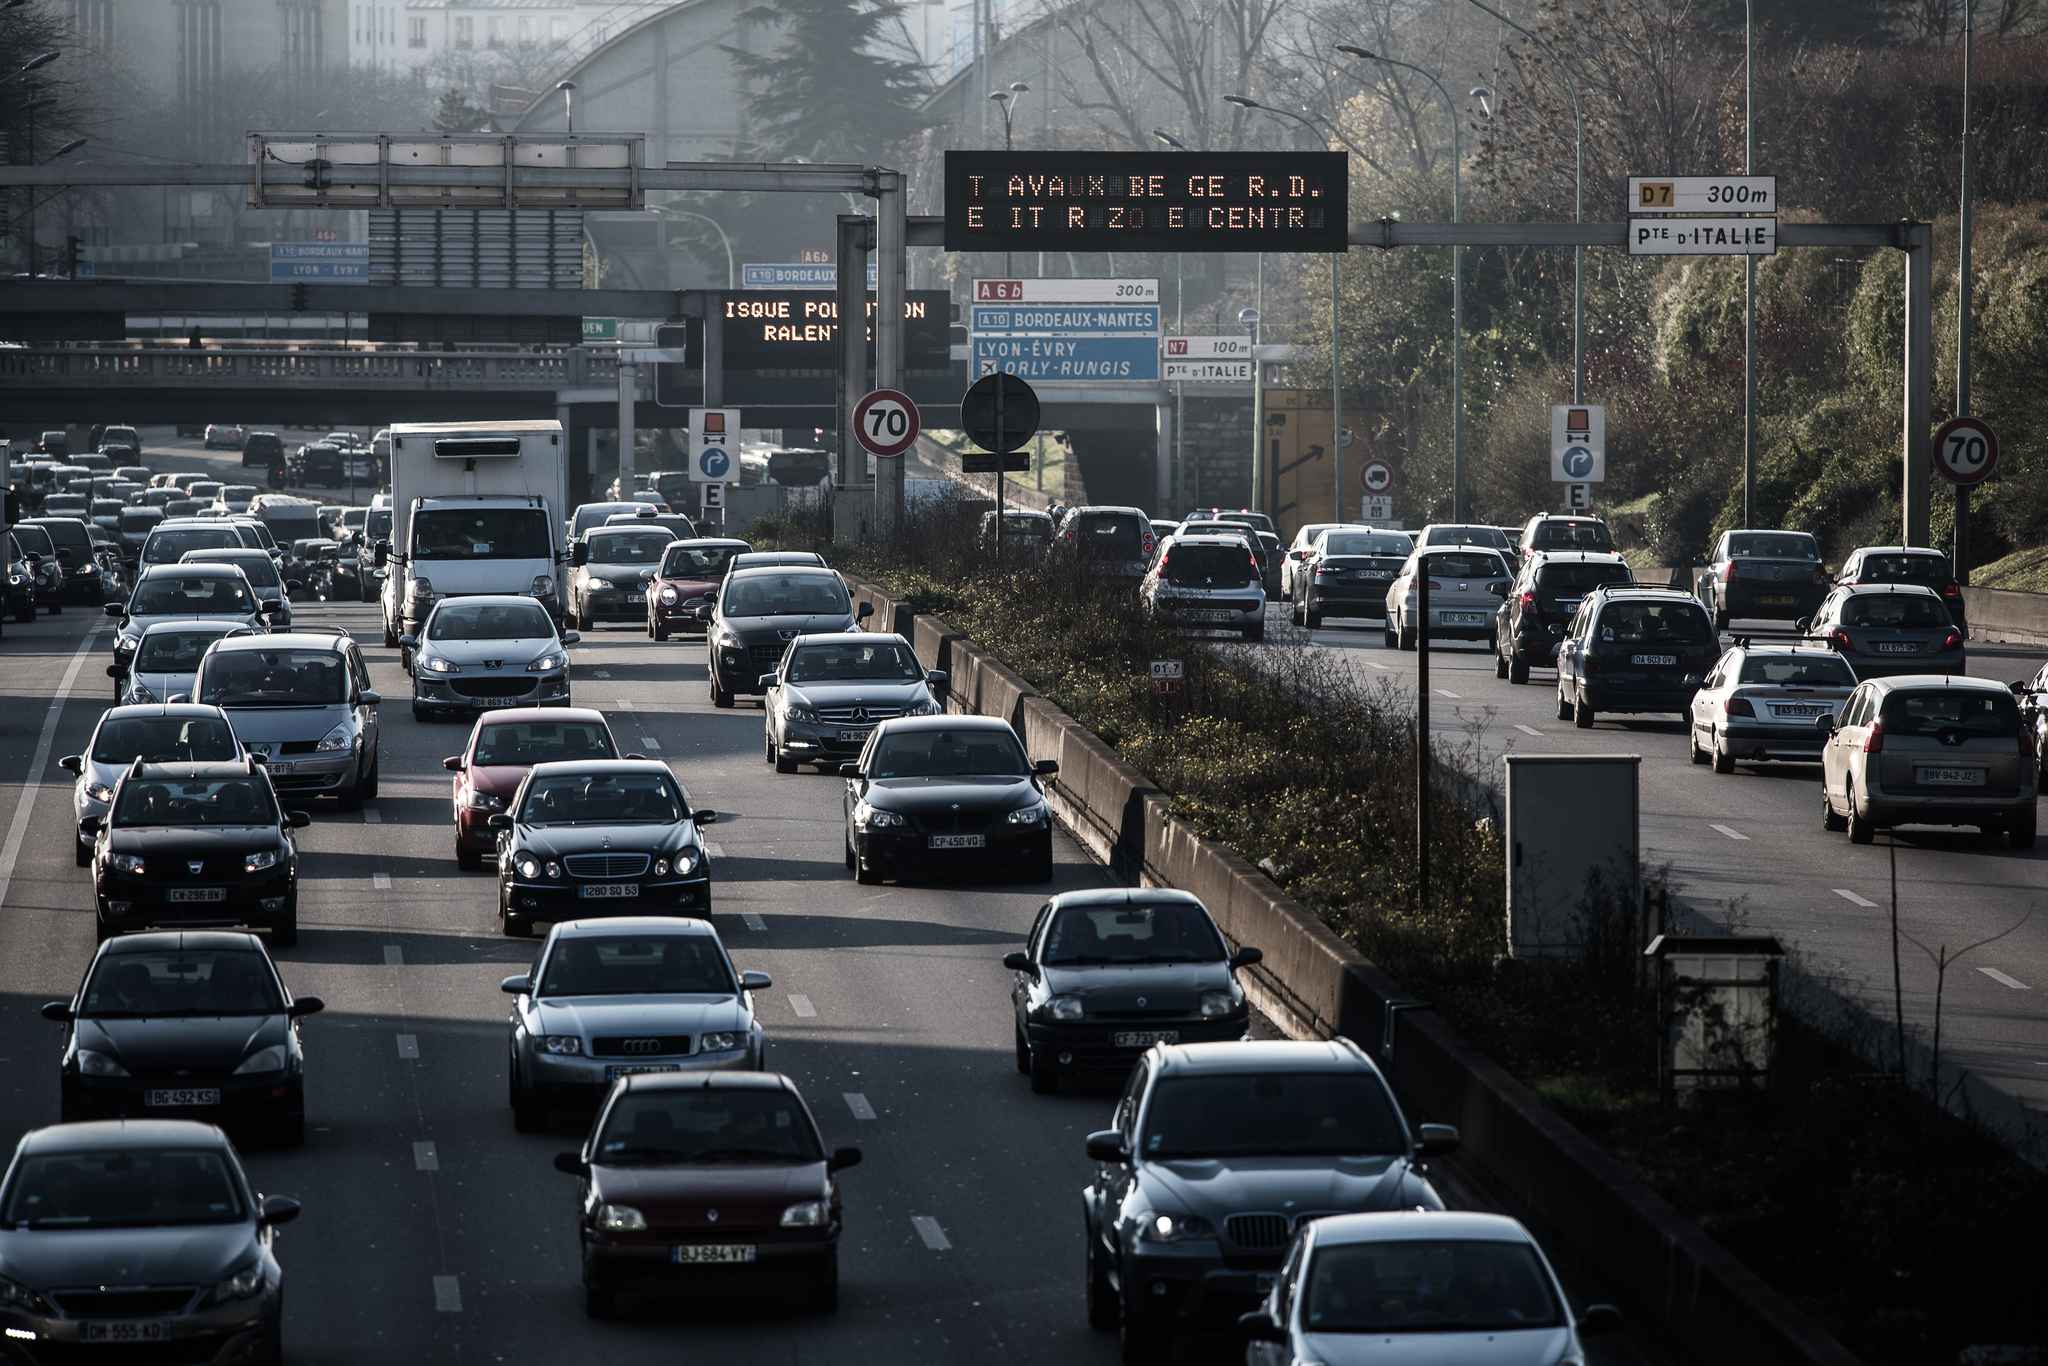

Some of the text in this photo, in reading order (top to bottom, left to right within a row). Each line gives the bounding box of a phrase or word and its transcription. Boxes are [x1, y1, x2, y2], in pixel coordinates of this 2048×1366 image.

[725, 302, 791, 318] ISQUE
[1014, 312, 1153, 328] BORDEAUX-NANTES
[1004, 361, 1132, 377] ORLY-RUNGIS
[868, 408, 907, 437] 70
[1947, 436, 1987, 465] 70
[706, 484, 721, 506] E
[1570, 485, 1586, 508] E
